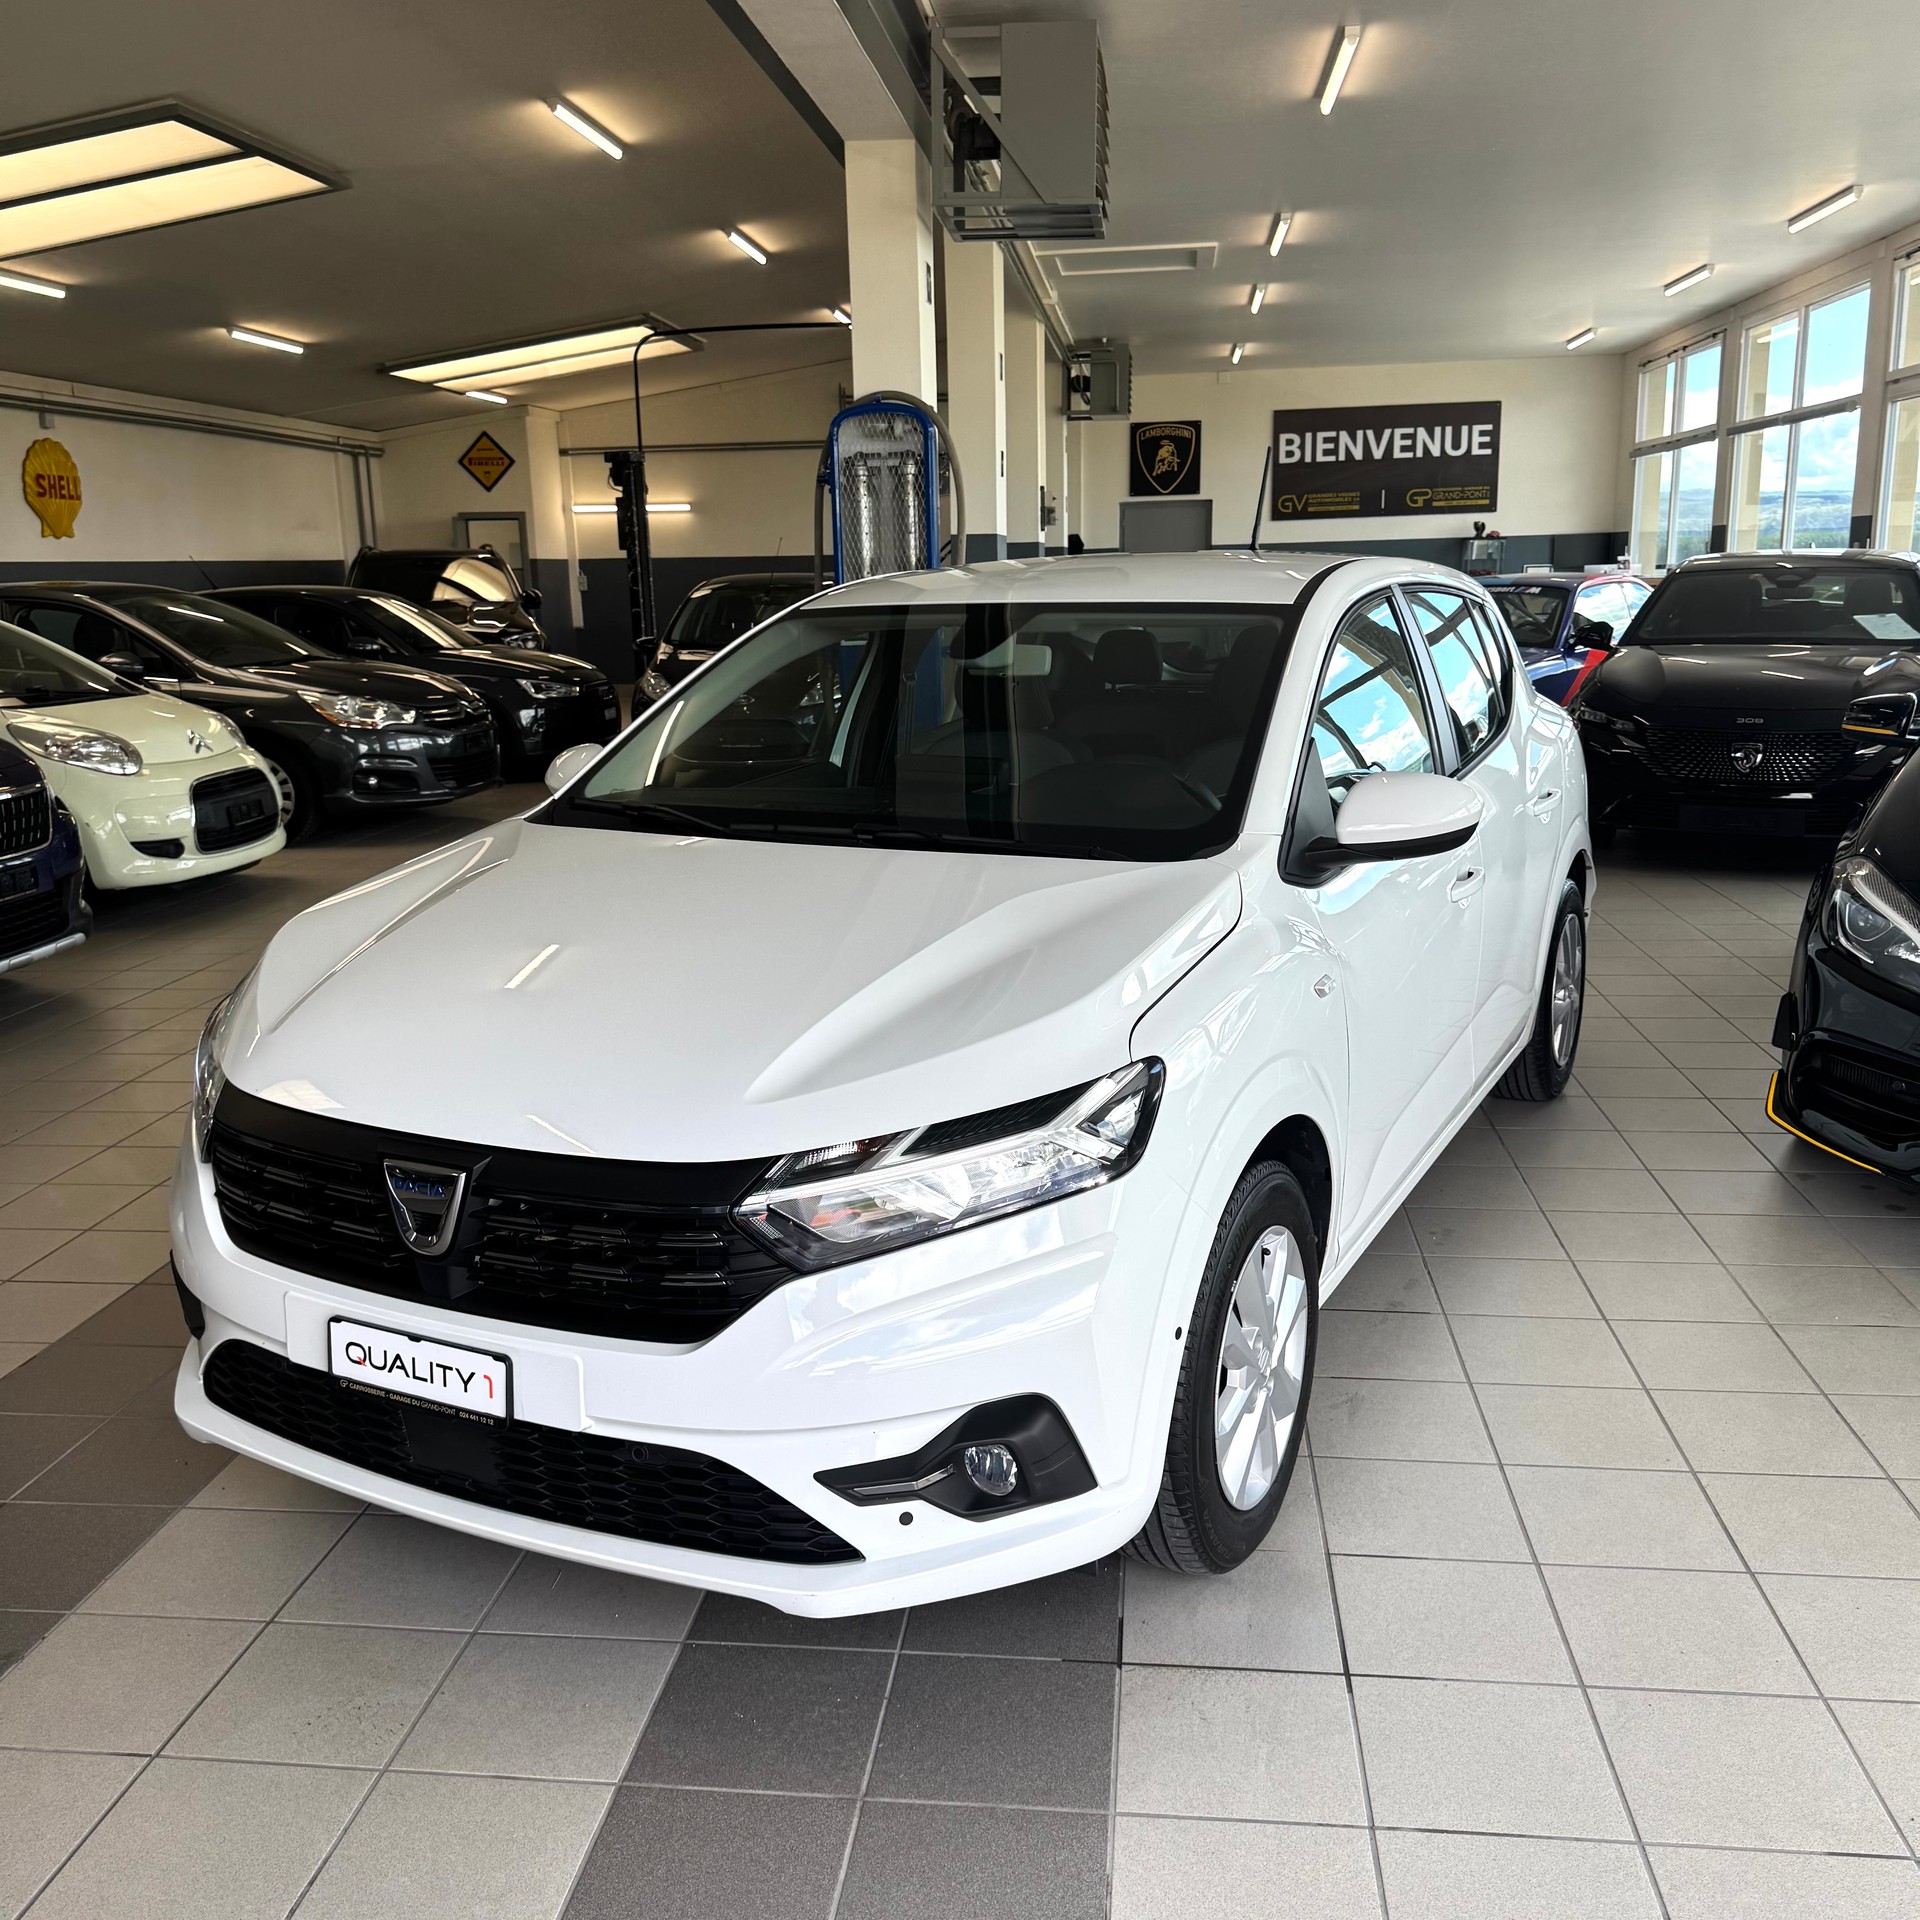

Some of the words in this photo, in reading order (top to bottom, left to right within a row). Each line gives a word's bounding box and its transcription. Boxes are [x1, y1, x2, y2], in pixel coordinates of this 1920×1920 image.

[1141, 427, 1192, 440] LAMBORGHINI
[1278, 424, 1494, 464] BIENVENUE
[35, 473, 81, 501] SHELL
[1278, 494, 1308, 513] GV
[392, 1177, 446, 1197] DACIA
[349, 1382, 386, 1398] CARROSSERIE
[389, 1393, 412, 1404] GARAGE
[412, 1398, 420, 1407] DU
[420, 1401, 456, 1415] GRAND-PONT
[459, 1411, 469, 1419] 024
